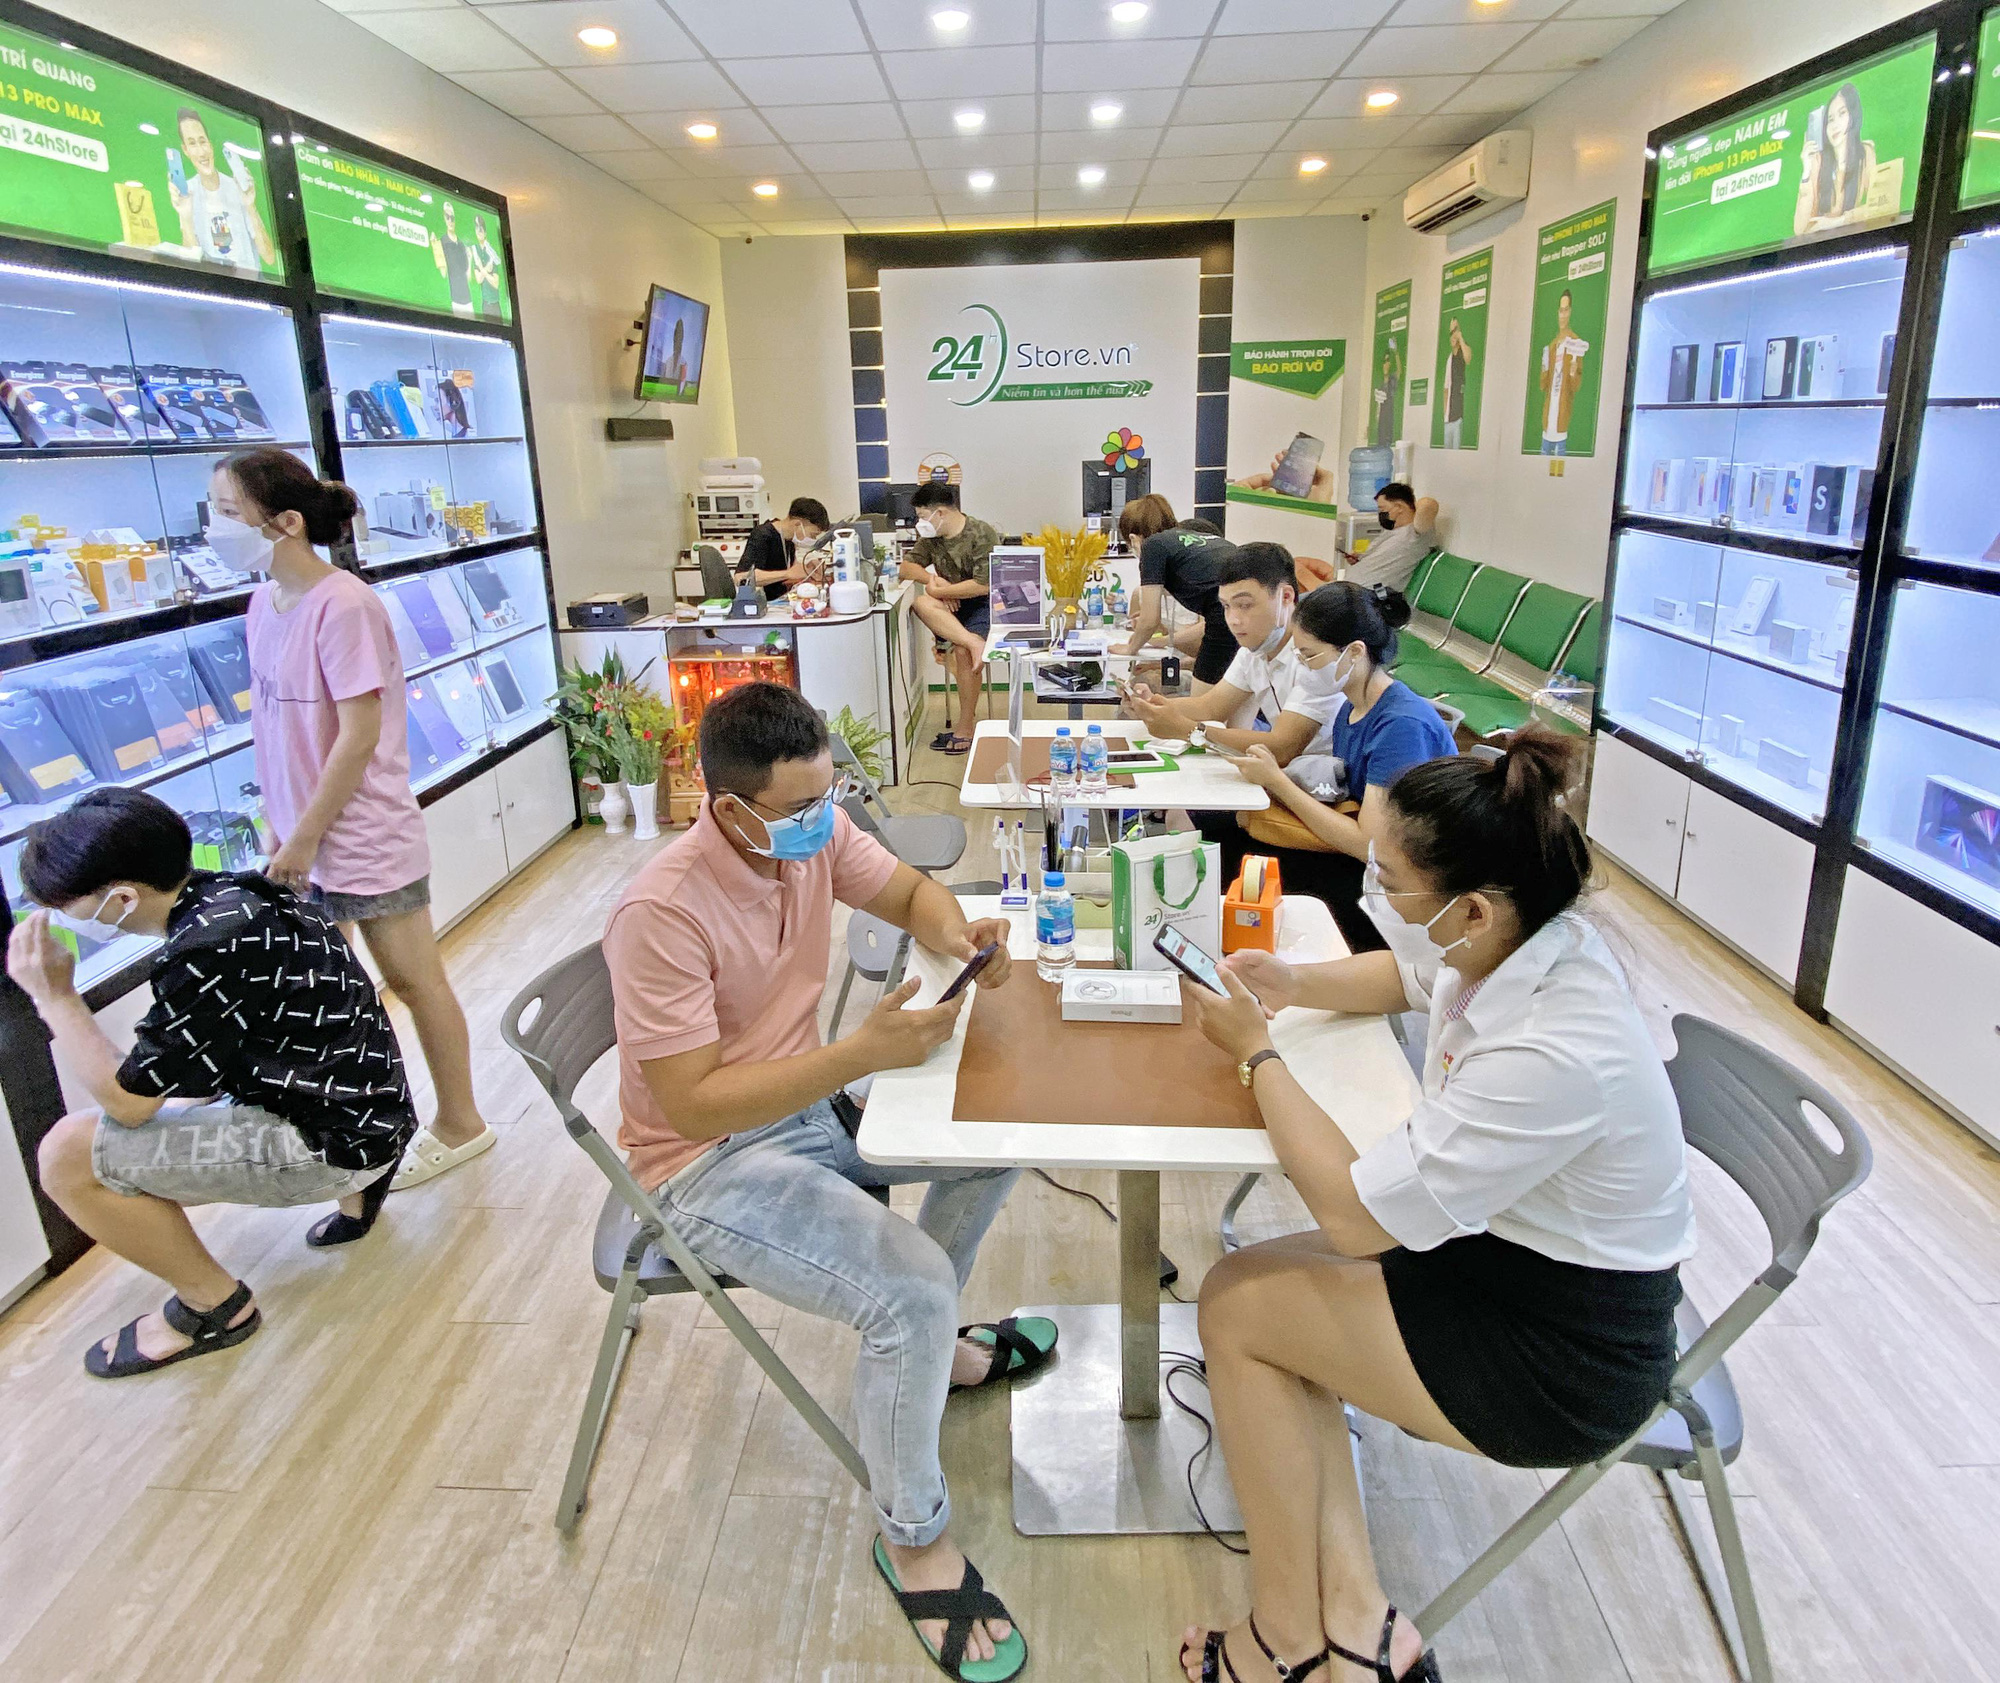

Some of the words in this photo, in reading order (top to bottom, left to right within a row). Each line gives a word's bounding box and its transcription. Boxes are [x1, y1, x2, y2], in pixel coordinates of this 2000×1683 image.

[32, 58, 97, 92] QUANG
[23, 88, 60, 114] PRO
[64, 101, 104, 127] MAX
[1714, 137, 1732, 154] đẹp
[1734, 119, 1763, 144] NAM
[1767, 110, 1788, 133] EM
[0, 124, 17, 145] ại
[22, 127, 98, 162] 24hStore
[1693, 161, 1724, 182] iPhone
[1726, 153, 1738, 169] 13
[1739, 148, 1757, 164] Pro
[1758, 139, 1783, 156] Max
[1730, 169, 1775, 191] 24hStore
[393, 223, 426, 243] 24hStore
[1588, 231, 1607, 248] SOL7
[1017, 342, 1131, 368] Store.vn
[1265, 349, 1289, 359] HÀNH
[1291, 349, 1315, 359] TRỌN
[10, 370, 44, 380] Energizer
[1252, 362, 1279, 374] BAO
[1305, 359, 1324, 372] VỠ
[56, 371, 87, 381] Energizer
[101, 375, 130, 385] Energizer
[149, 375, 179, 386] Energizer
[186, 376, 214, 386] Energizer
[1002, 384, 1030, 399] Niềm
[1033, 387, 1047, 398] tin
[1050, 386, 1062, 397] và
[1064, 385, 1083, 397] hơn
[1086, 383, 1102, 396] thế
[1814, 485, 1828, 511] S
[1050, 760, 1068, 769] aVie
